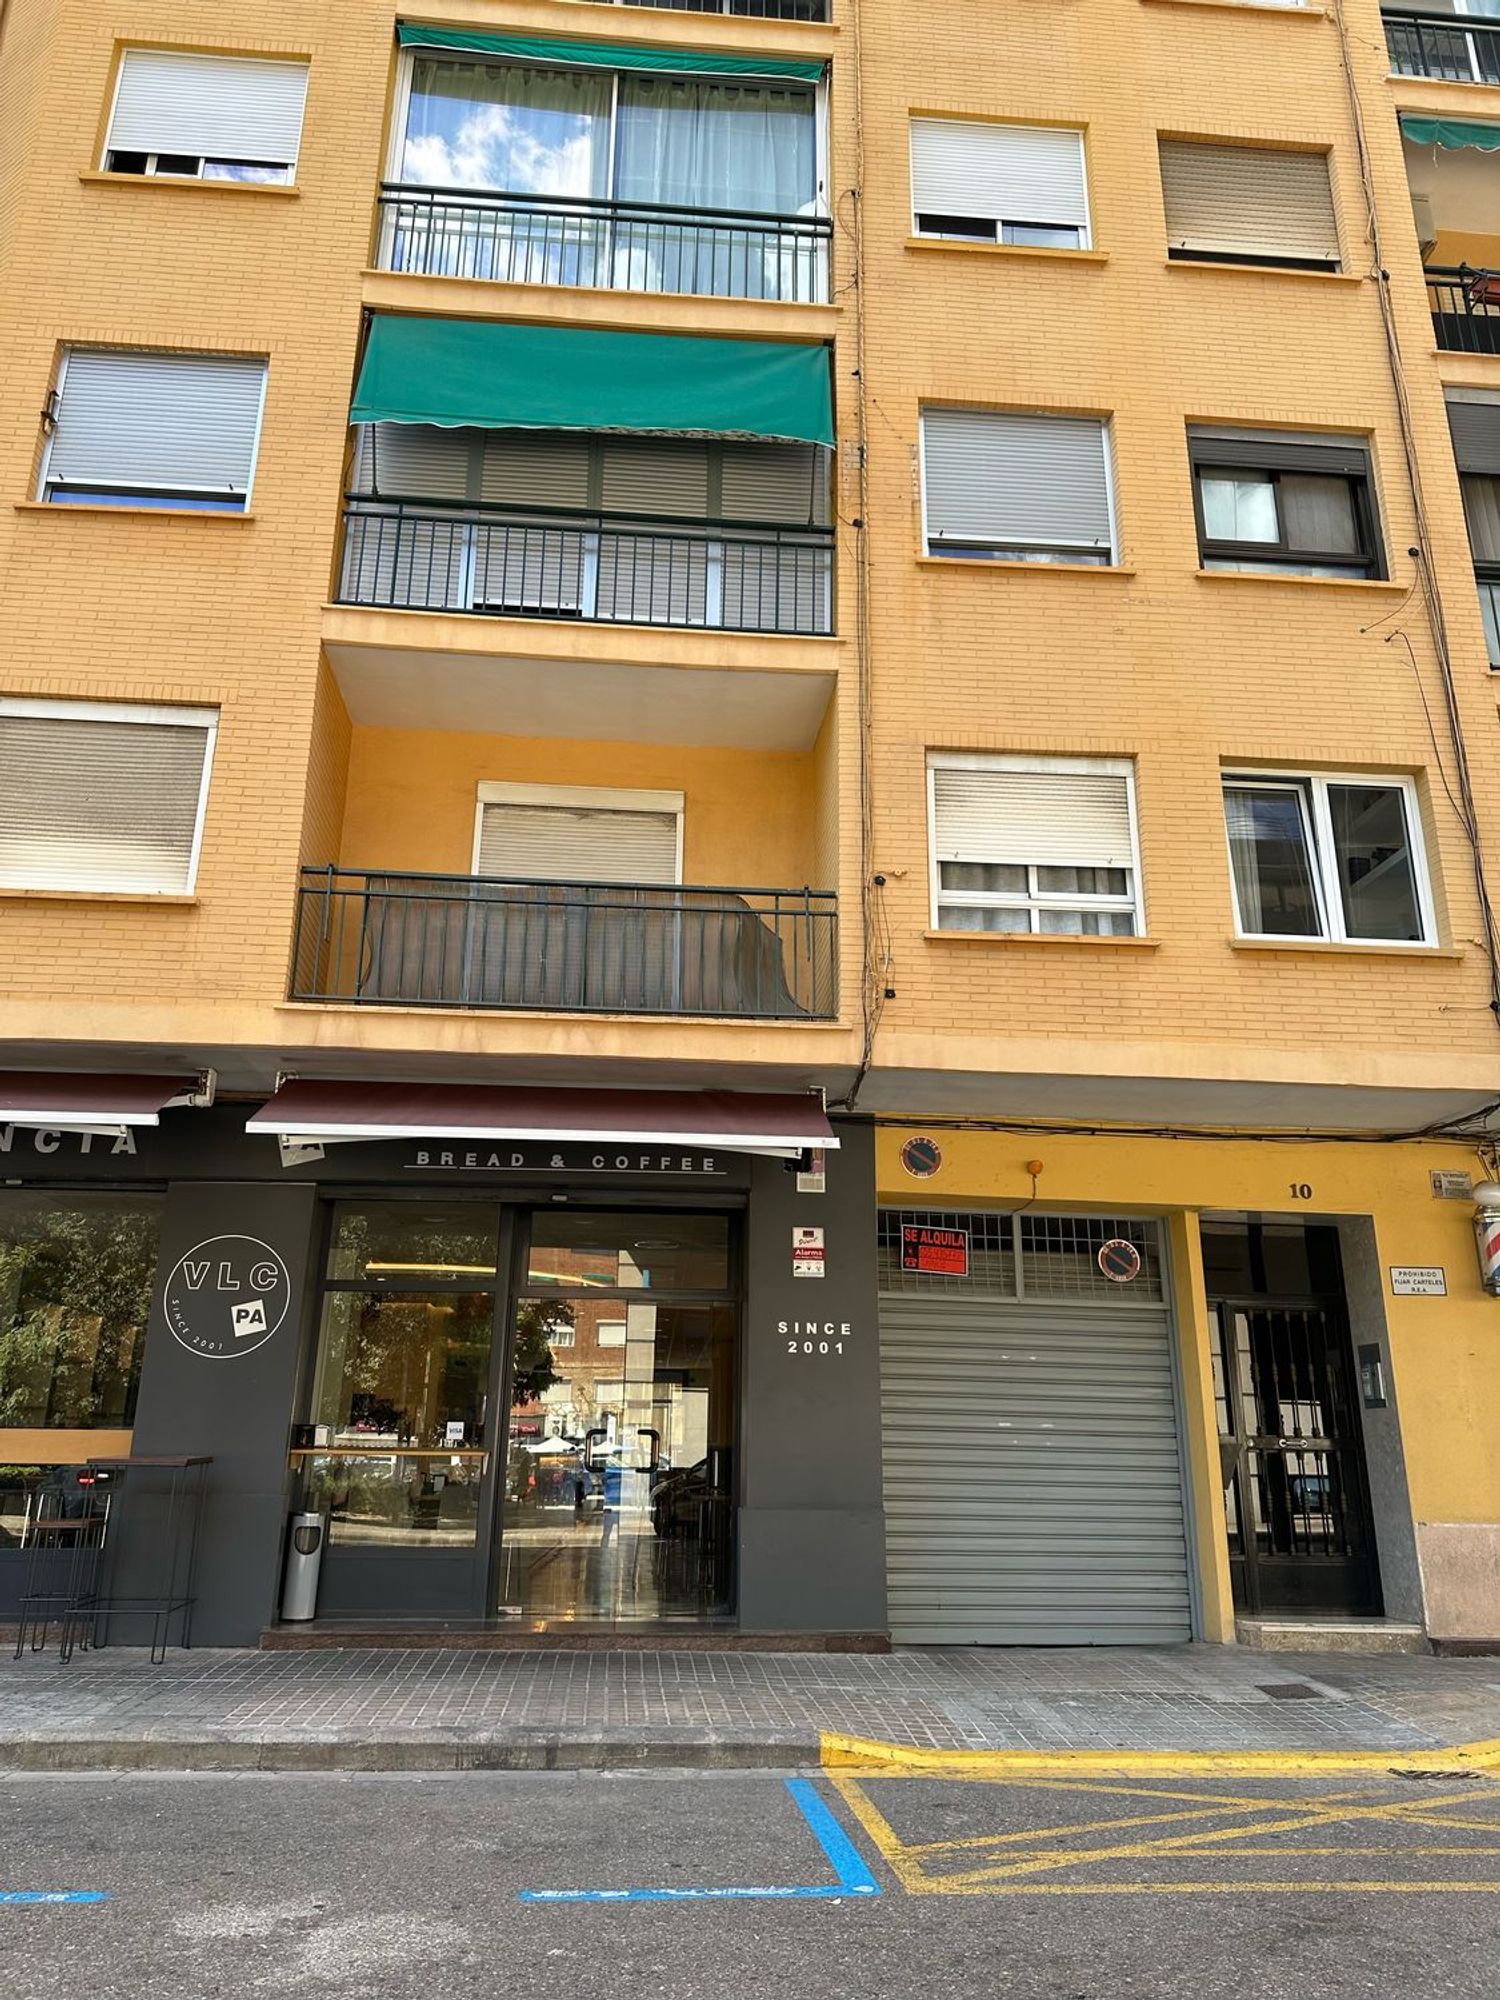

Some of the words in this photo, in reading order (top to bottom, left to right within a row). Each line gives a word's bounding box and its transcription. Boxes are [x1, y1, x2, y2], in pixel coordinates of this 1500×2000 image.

[417, 1151, 524, 1167] BREAD
[550, 1154, 566, 1168] &
[592, 1155, 715, 1171] COFFEE
[1288, 1183, 1312, 1200] 10
[904, 1228, 918, 1243] SE
[920, 1230, 965, 1248] ALQUILA
[182, 1261, 279, 1292] VLC
[172, 1299, 190, 1334] SINCE
[192, 1335, 223, 1351] 2001
[235, 1308, 264, 1324] PA
[777, 1321, 851, 1336] SINCE
[787, 1341, 843, 1355] 2001
